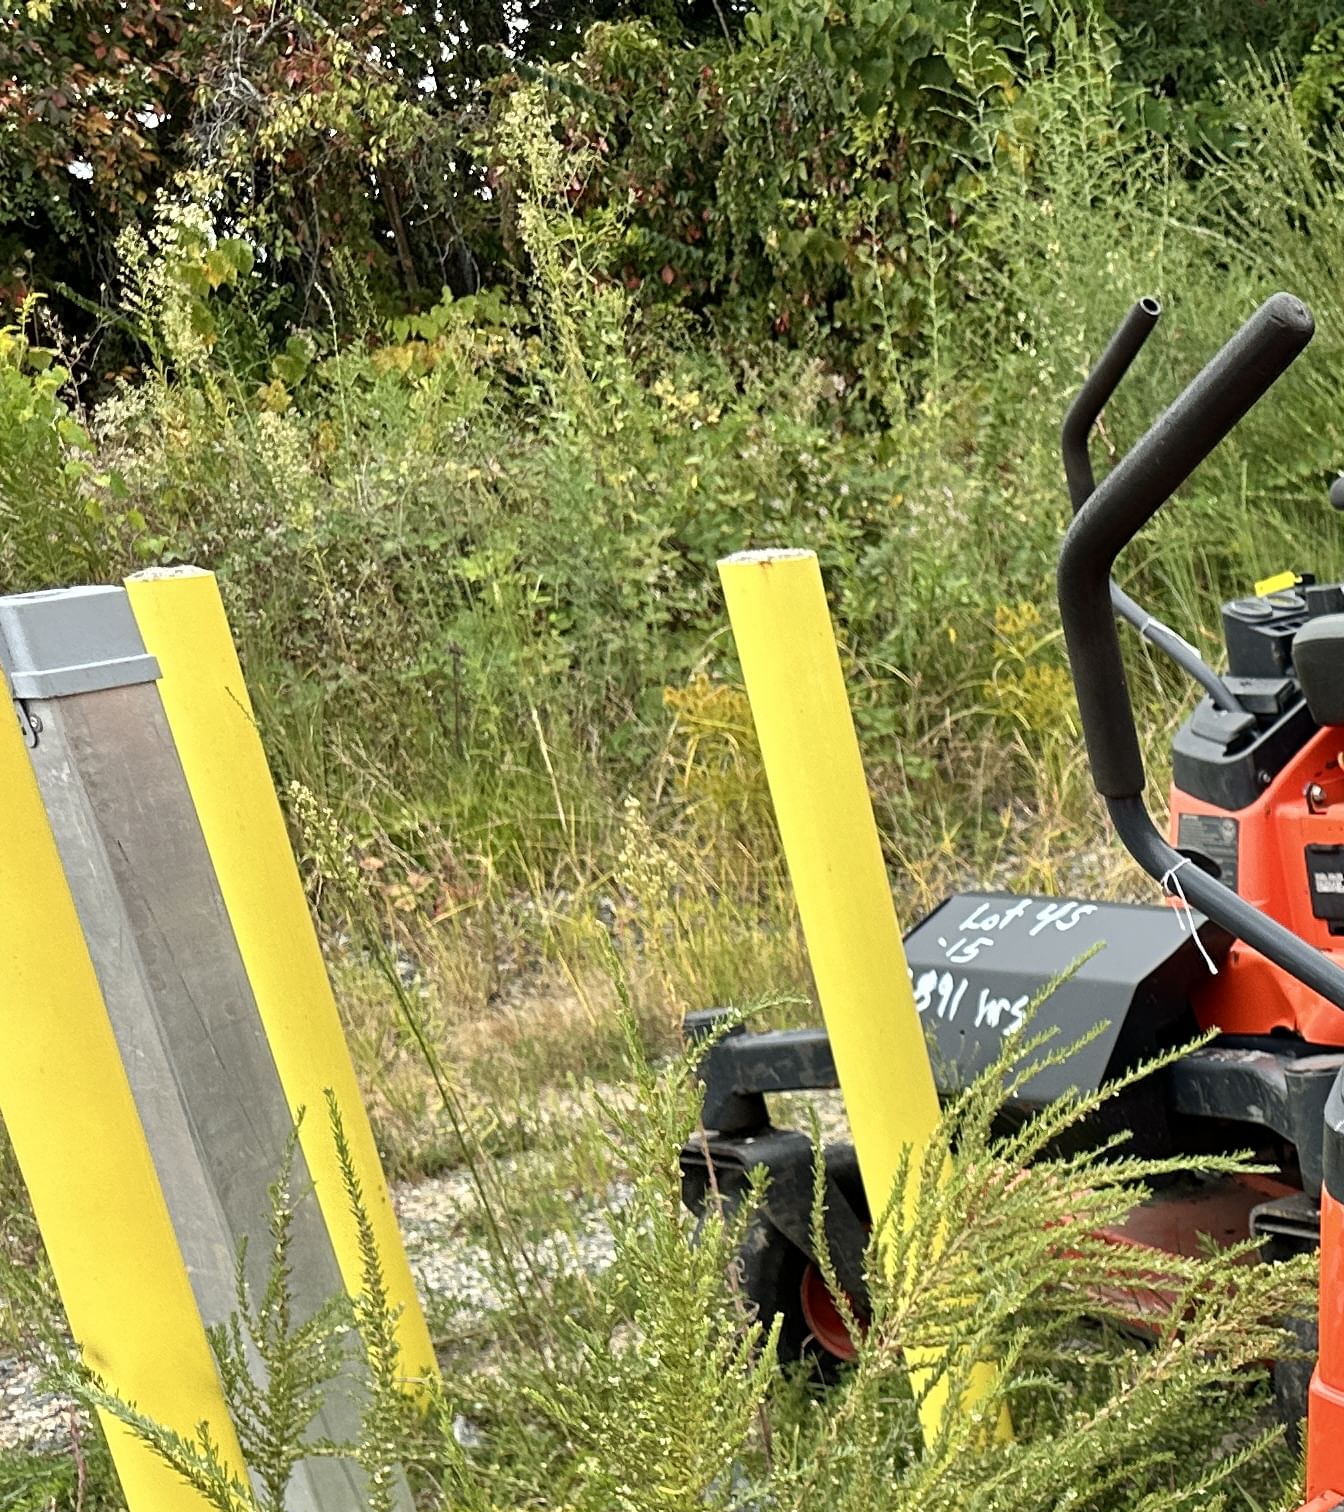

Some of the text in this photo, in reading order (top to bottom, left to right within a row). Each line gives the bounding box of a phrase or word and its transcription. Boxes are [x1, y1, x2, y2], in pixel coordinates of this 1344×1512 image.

[959, 898, 1098, 936] Lot 45
[908, 968, 968, 1019] 891
